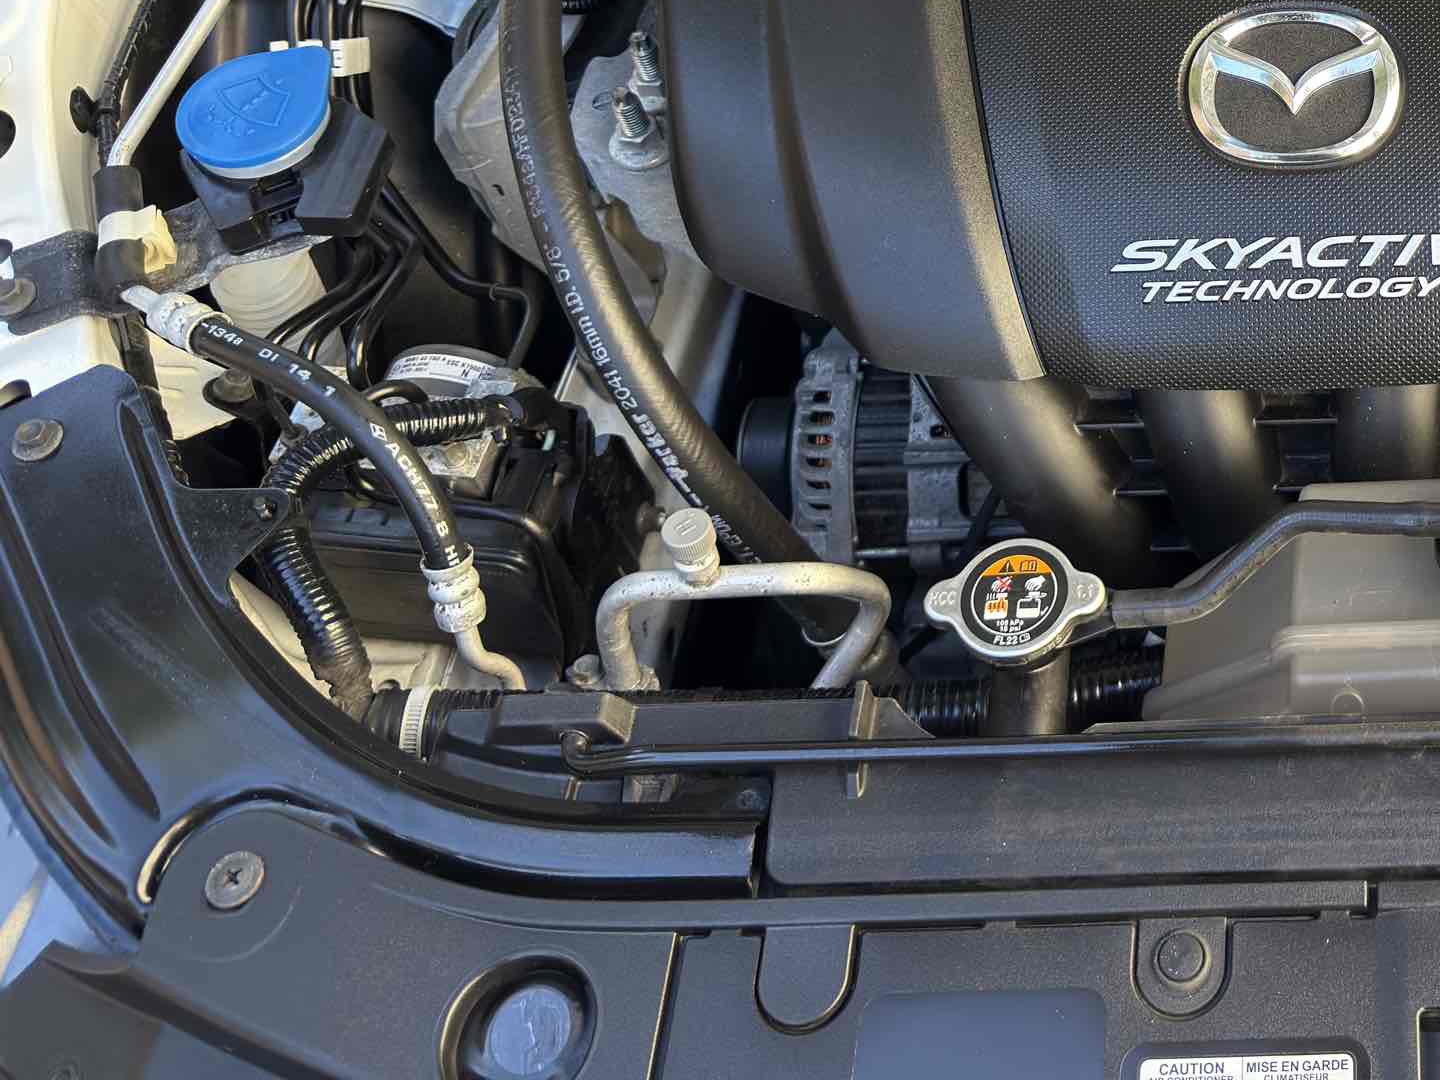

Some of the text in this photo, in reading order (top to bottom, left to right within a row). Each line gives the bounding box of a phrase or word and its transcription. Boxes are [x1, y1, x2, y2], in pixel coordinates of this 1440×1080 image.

[578, 316, 612, 367] 16mm
[603, 370, 637, 410] 2041
[993, 635, 1018, 646] FL22
[1159, 1062, 1225, 1076] CAUTION
[1246, 1059, 1350, 1073] MISE EN GARDE
